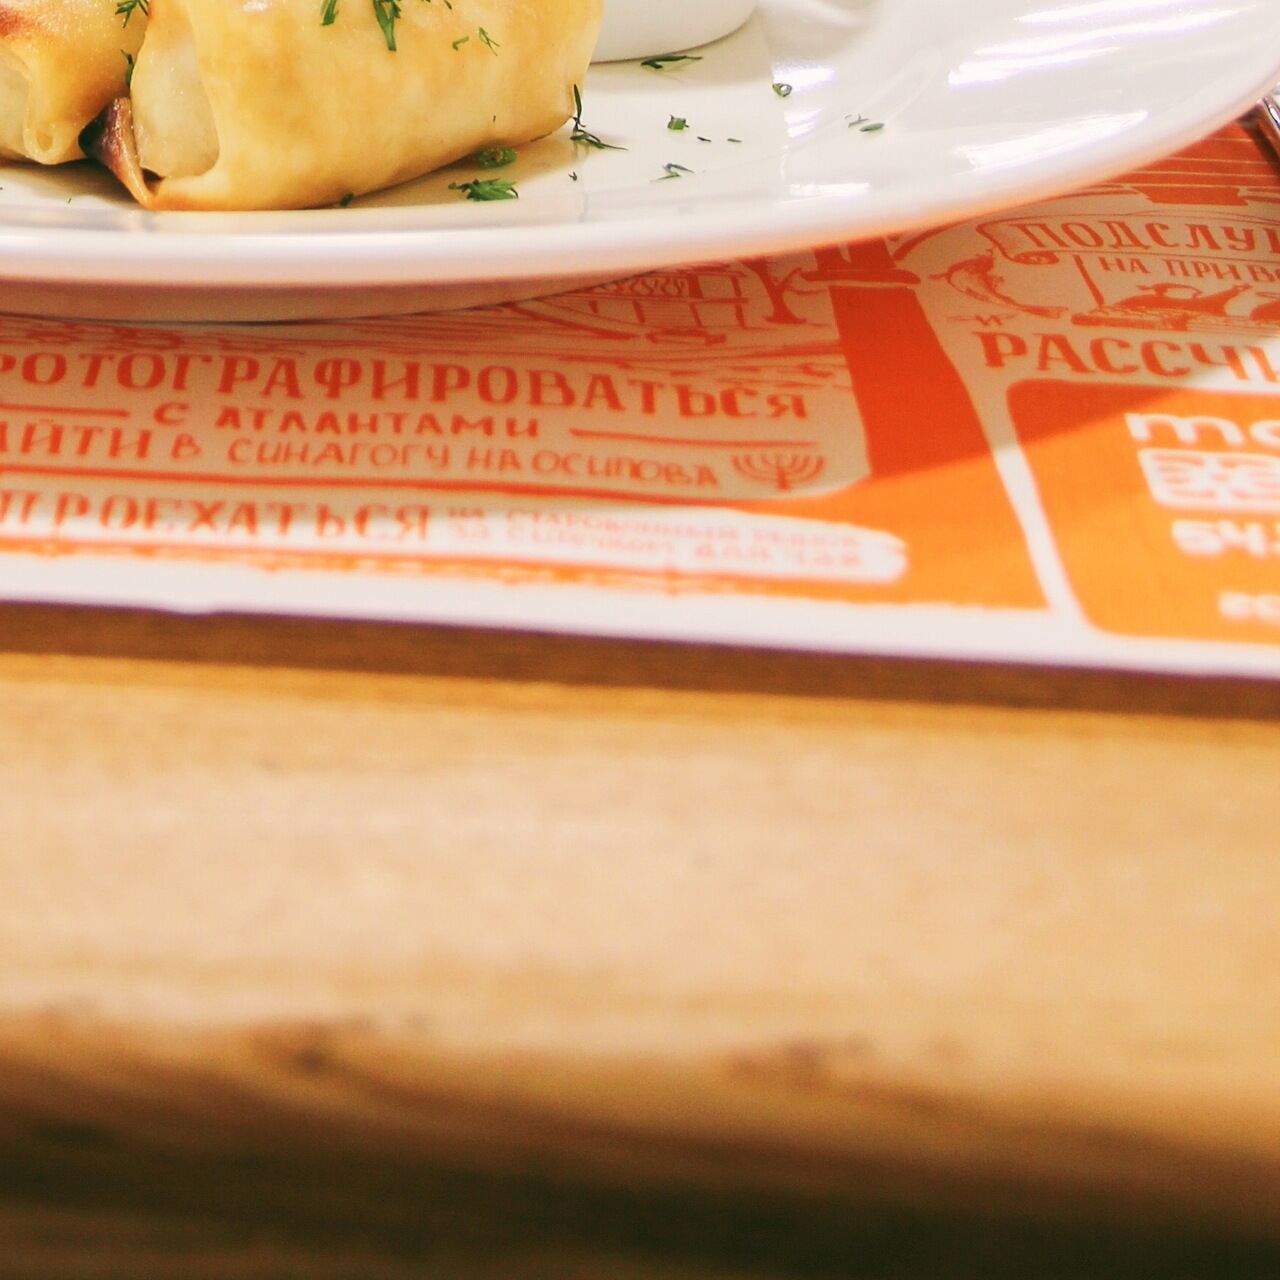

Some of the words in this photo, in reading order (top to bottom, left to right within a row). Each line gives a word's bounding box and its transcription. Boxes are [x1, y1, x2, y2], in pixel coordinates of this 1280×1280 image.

[1098, 256, 1151, 274] НА
[1164, 258, 1280, 283] ПРИВ
[215, 406, 539, 438] АТЛАНТАМИ
[227, 438, 451, 469] СИНАГОГУ
